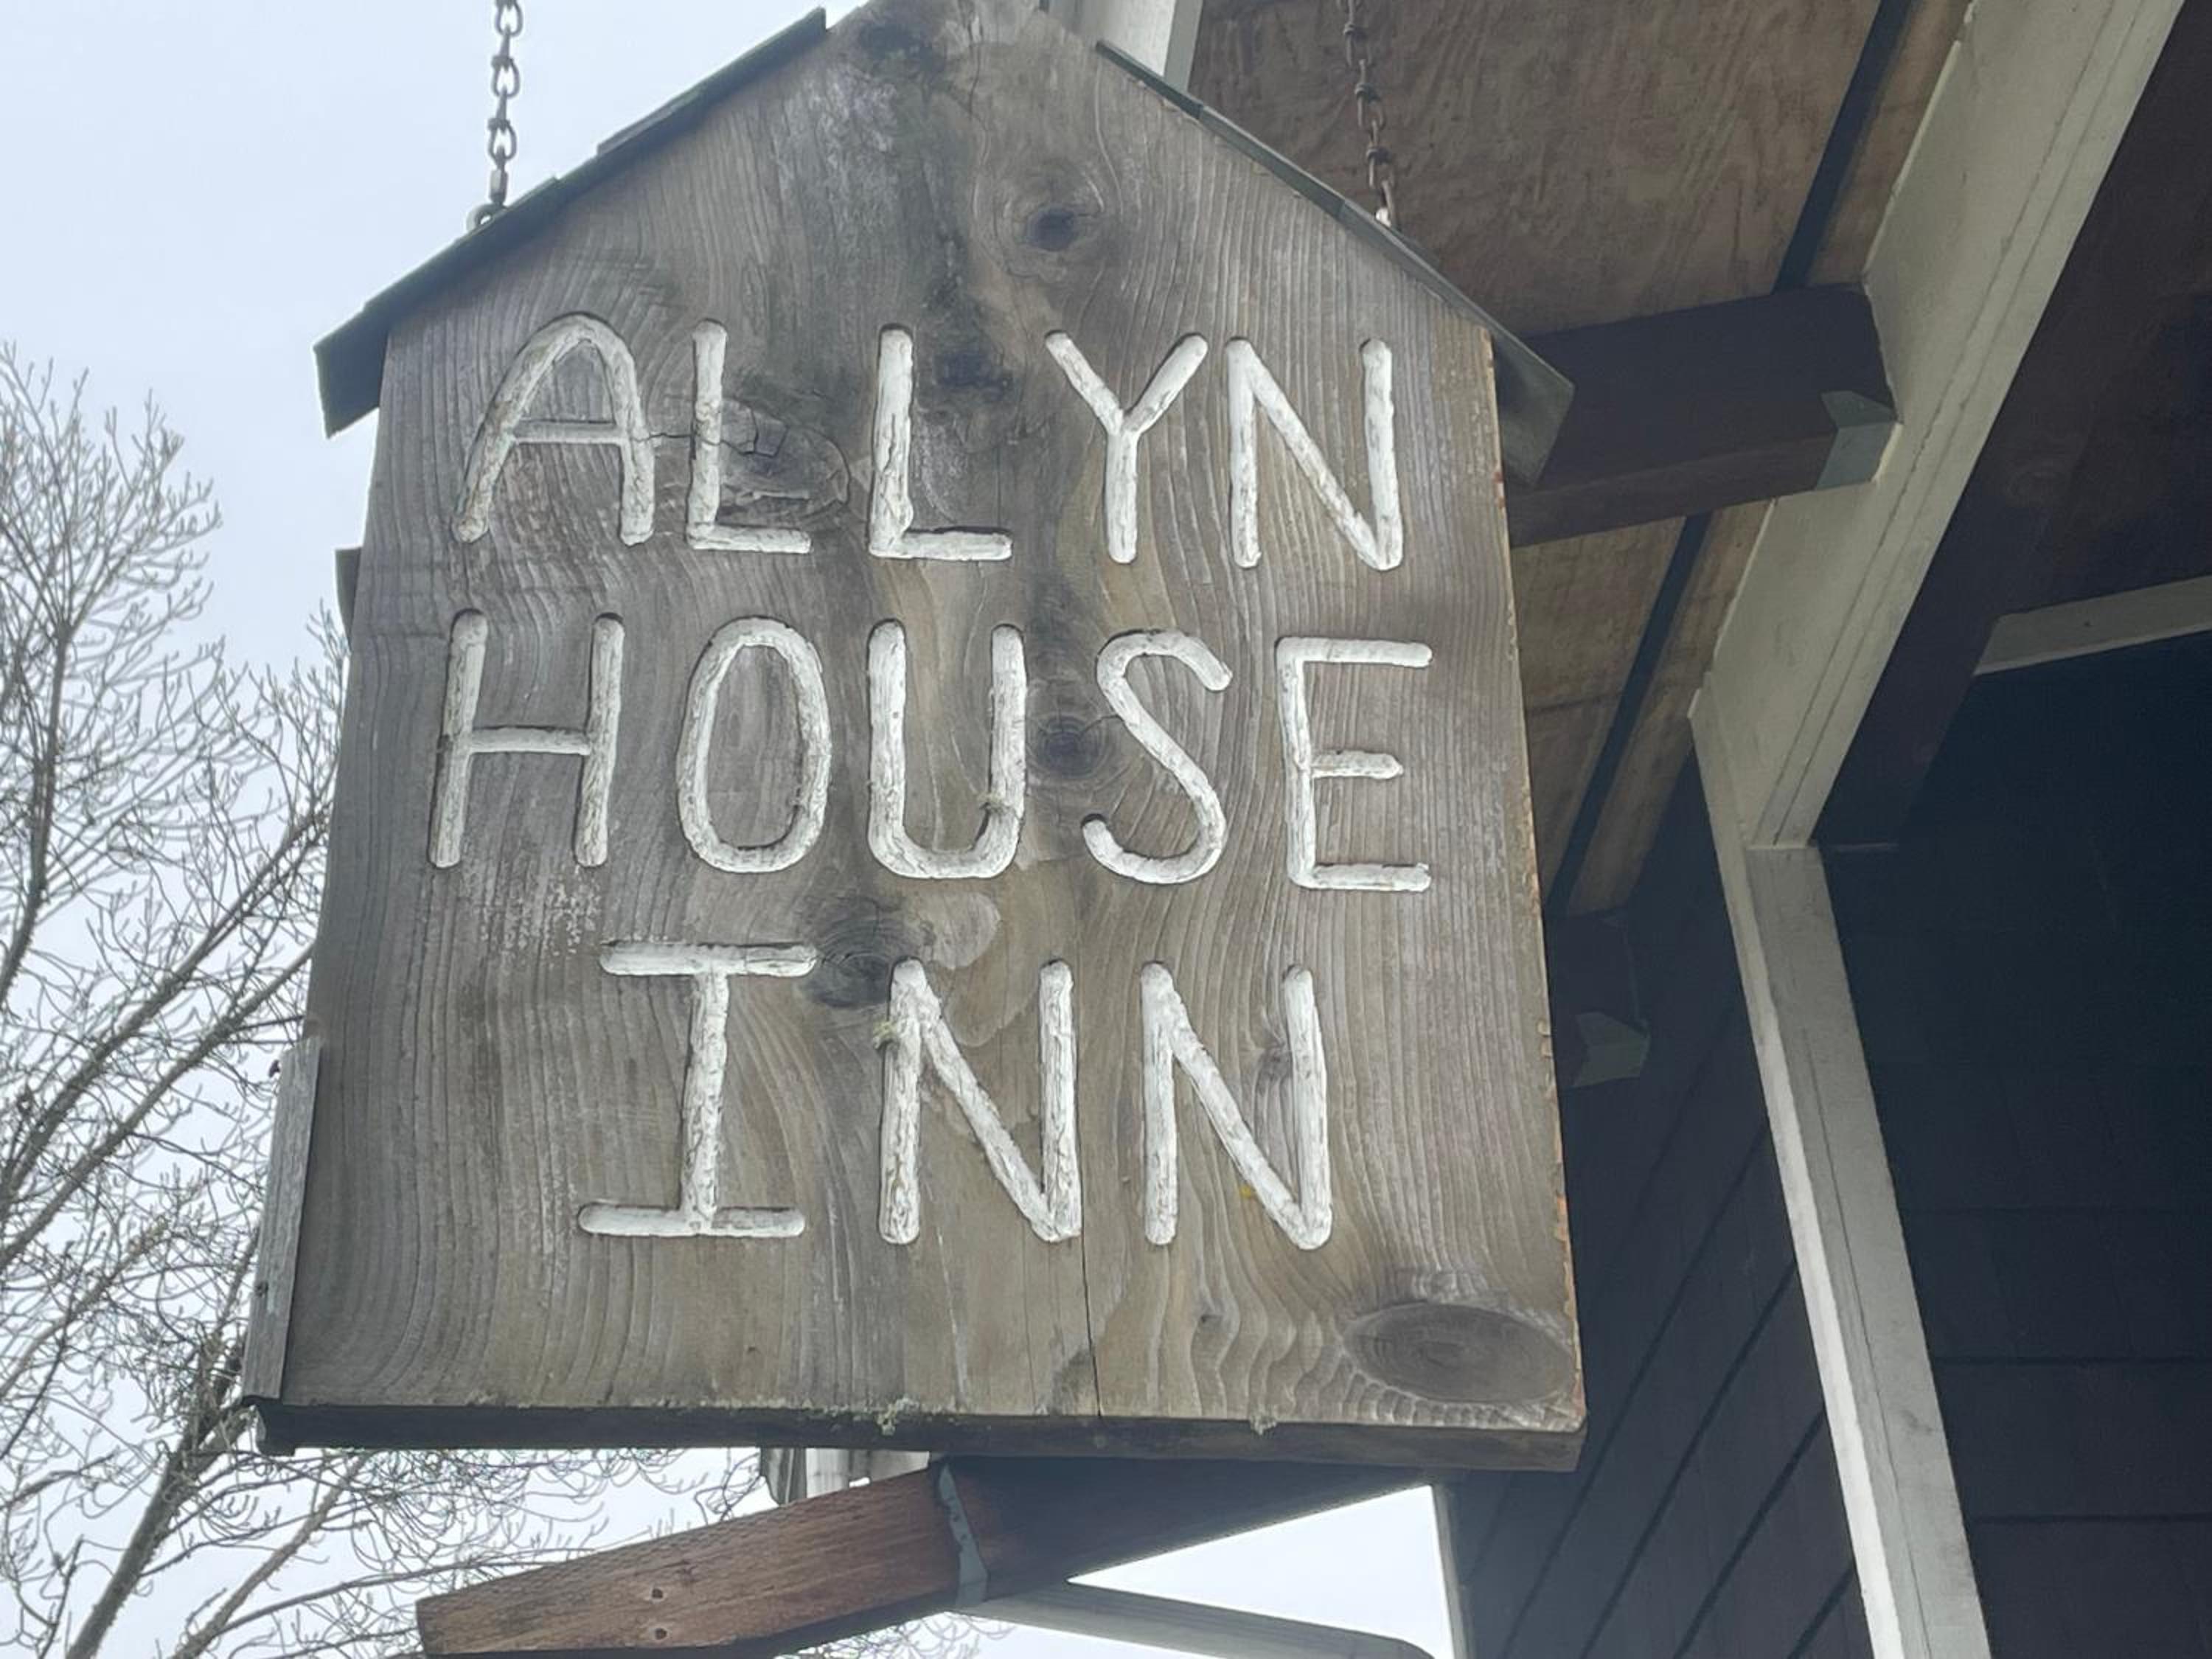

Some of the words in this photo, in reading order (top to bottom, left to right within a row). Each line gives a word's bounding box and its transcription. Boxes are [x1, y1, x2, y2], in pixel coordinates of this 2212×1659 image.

[454, 313, 1404, 572] ALLYN
[430, 611, 1433, 894] HOUSE
[579, 939, 1333, 1251] INN
